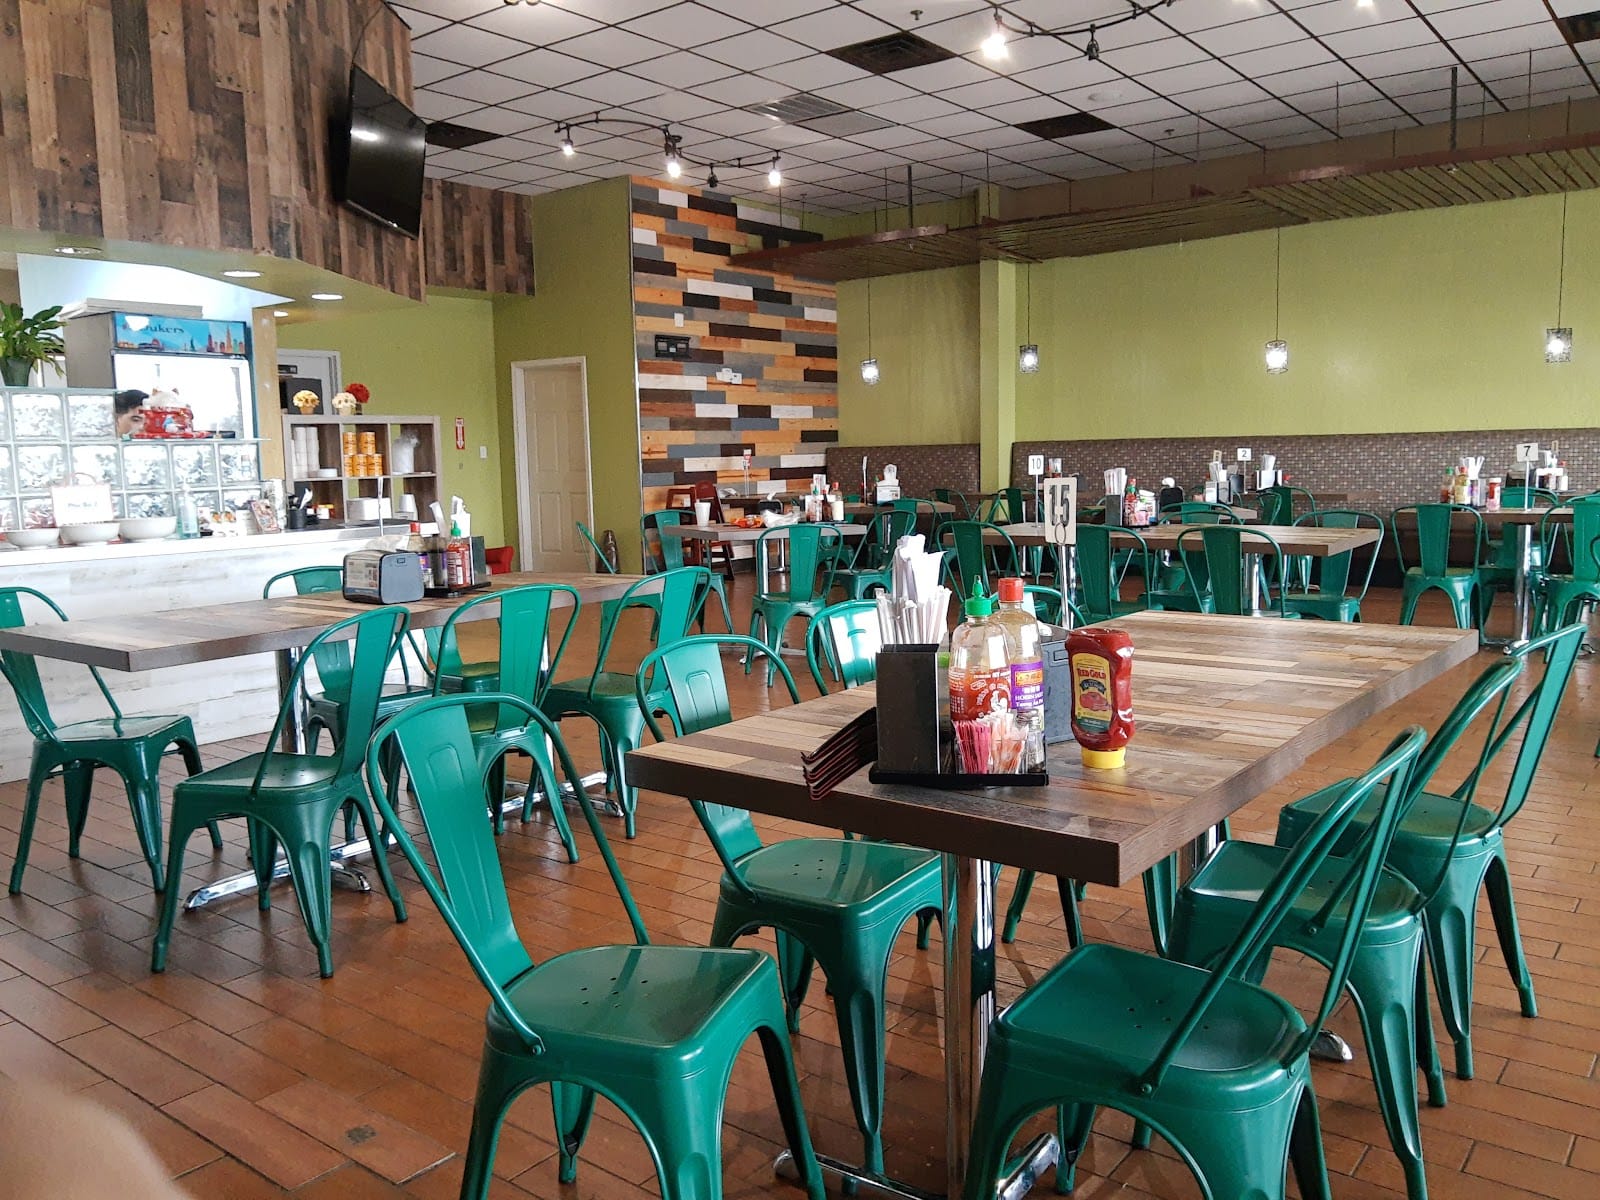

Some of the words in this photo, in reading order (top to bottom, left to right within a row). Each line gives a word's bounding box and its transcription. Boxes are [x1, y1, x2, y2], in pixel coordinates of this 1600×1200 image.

[1523, 445, 1531, 456] 7
[1031, 458, 1042, 470] 10
[1049, 484, 1070, 527] 15
